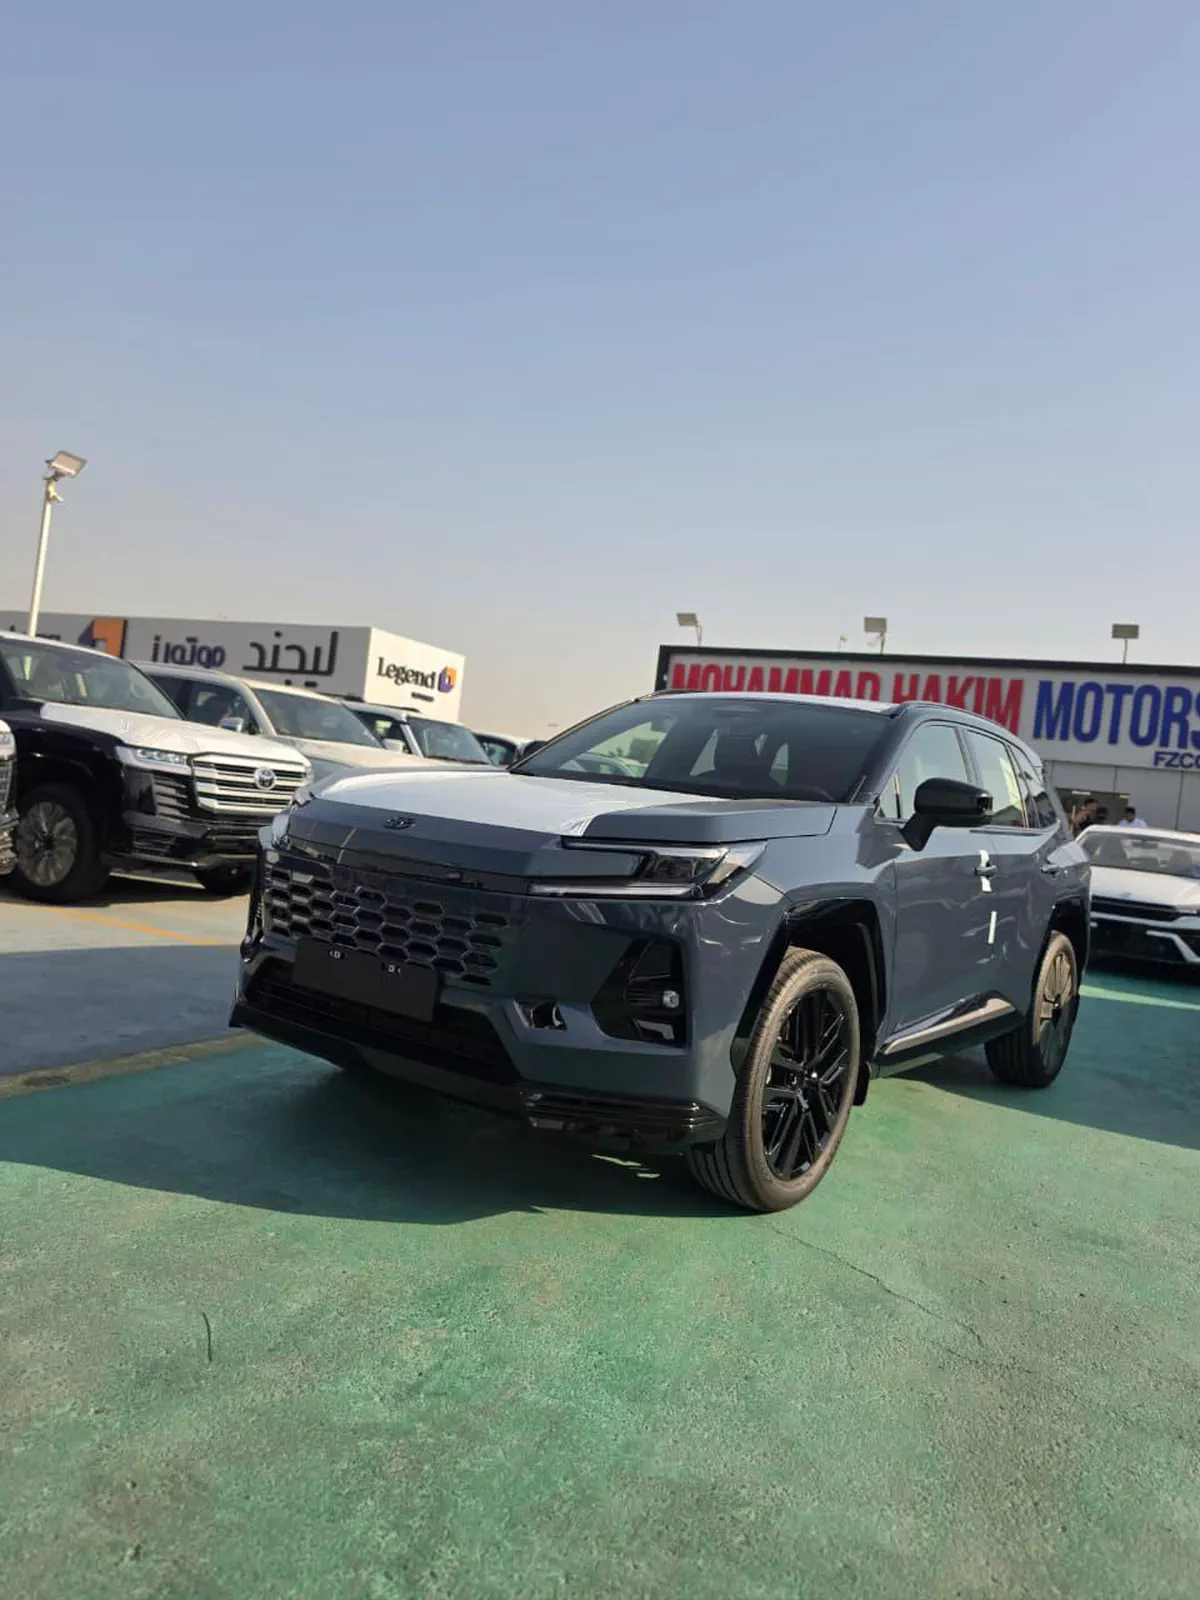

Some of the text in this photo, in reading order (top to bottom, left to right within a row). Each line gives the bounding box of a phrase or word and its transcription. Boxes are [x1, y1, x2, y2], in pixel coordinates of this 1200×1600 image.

[242, 631, 338, 688] ليجند
[376, 656, 436, 689] Legend
[892, 673, 1023, 736] HAKIM
